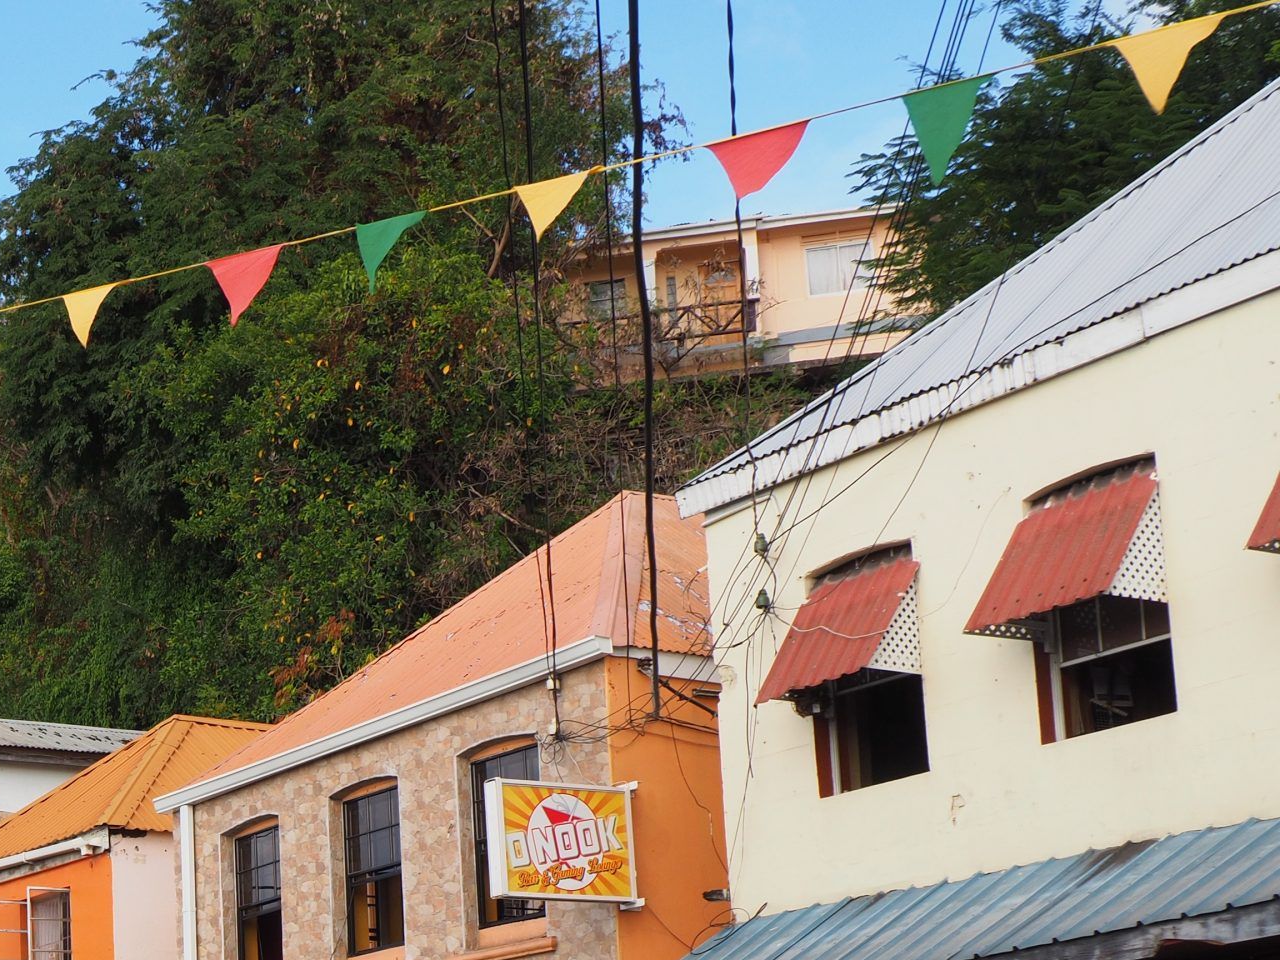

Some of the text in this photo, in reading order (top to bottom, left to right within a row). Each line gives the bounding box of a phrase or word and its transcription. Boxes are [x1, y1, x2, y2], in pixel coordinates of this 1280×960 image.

[518, 871, 540, 888] Bar
[549, 863, 586, 885] Gaming
[587, 857, 623, 875] Lounge
